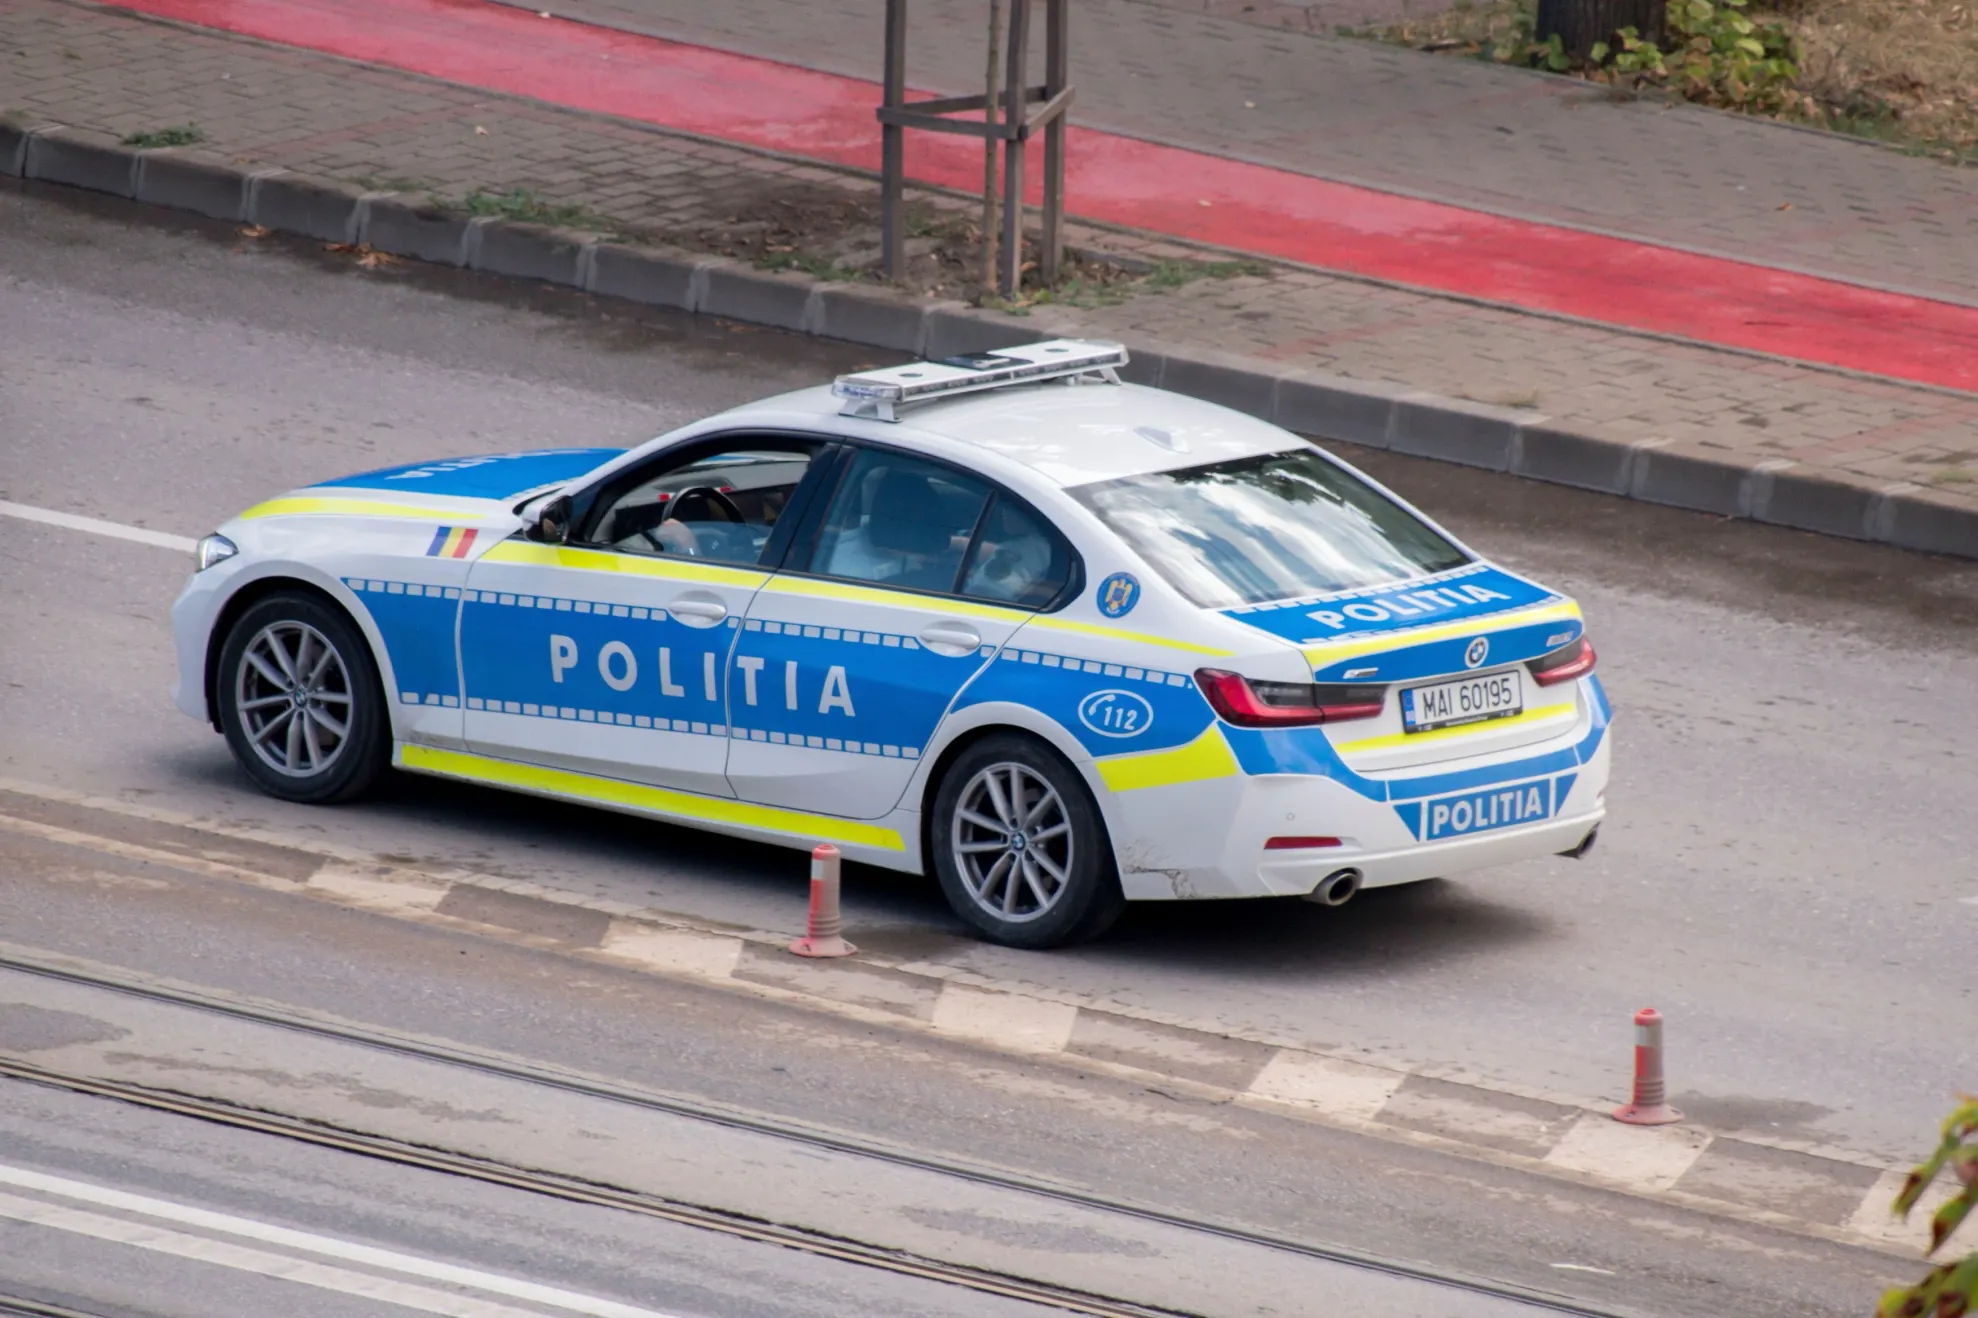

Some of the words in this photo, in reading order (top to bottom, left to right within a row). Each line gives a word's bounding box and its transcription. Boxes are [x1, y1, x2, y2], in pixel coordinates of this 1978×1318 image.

[1305, 584, 1512, 630] POLITIA
[550, 634, 856, 717] POLITIA
[1422, 687, 1453, 719] MAI
[1460, 677, 1512, 712] 60195
[1104, 706, 1138, 731] 112
[1432, 786, 1543, 836] POLITIA
